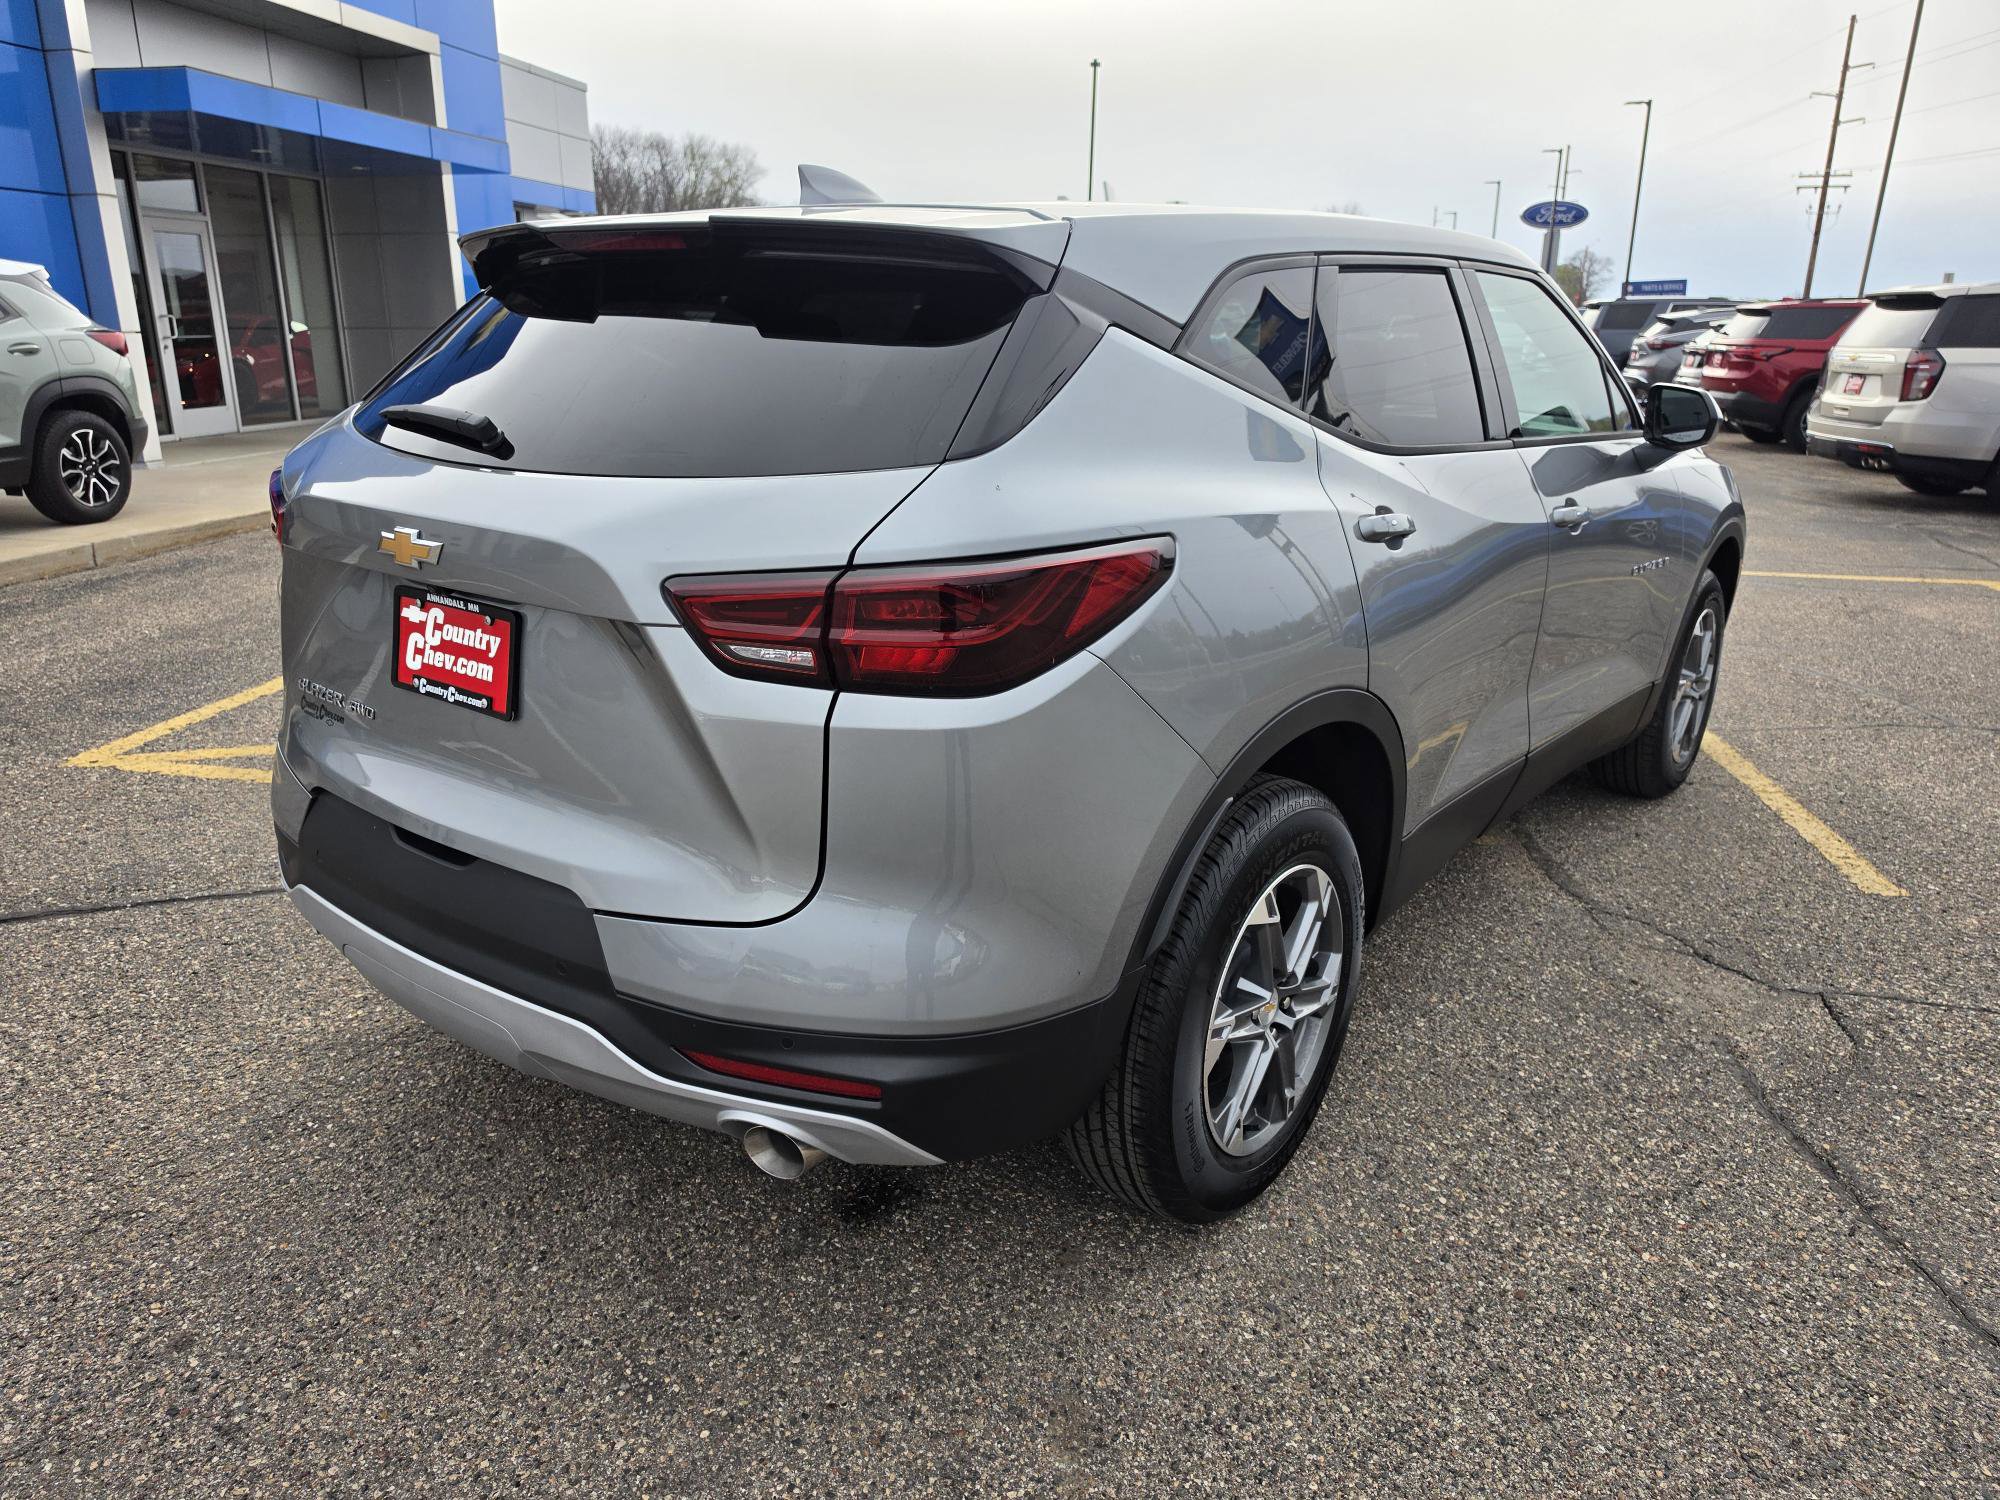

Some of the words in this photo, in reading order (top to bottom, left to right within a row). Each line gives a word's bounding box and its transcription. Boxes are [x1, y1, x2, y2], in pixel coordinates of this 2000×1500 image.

[1535, 206, 1576, 223] Ford
[426, 593, 466, 610] ANNANDALE,
[467, 602, 480, 613] MN
[425, 607, 502, 659] Country
[405, 632, 494, 683] Chev.com
[419, 677, 482, 708] CountryChev.com
